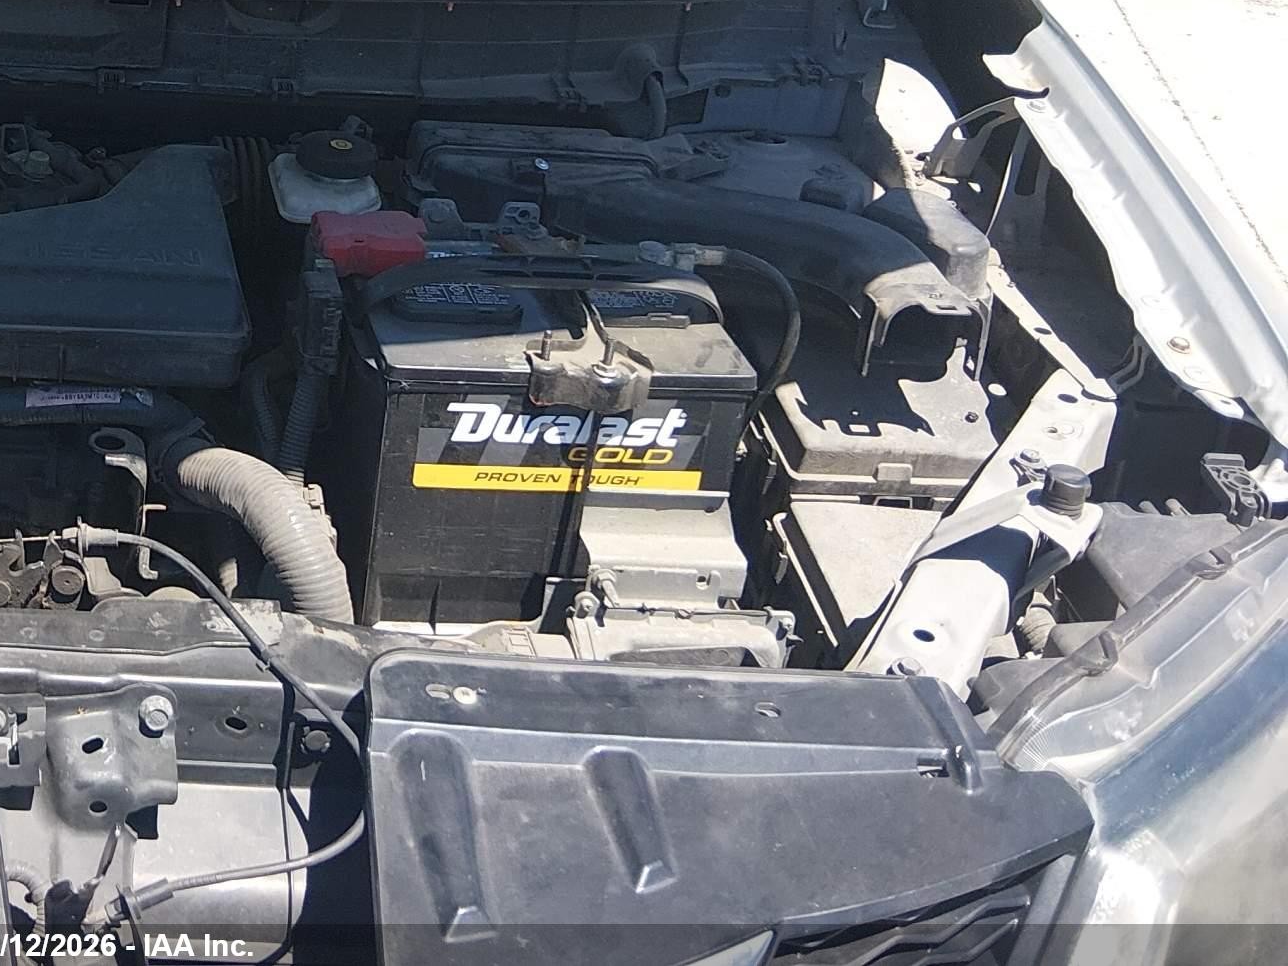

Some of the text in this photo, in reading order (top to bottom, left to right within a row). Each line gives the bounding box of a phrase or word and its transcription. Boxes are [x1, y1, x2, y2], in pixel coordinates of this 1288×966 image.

[446, 402, 688, 447] Duralast
[568, 446, 674, 464] GOLD
[474, 472, 641, 486] PROVEN TOUGH
